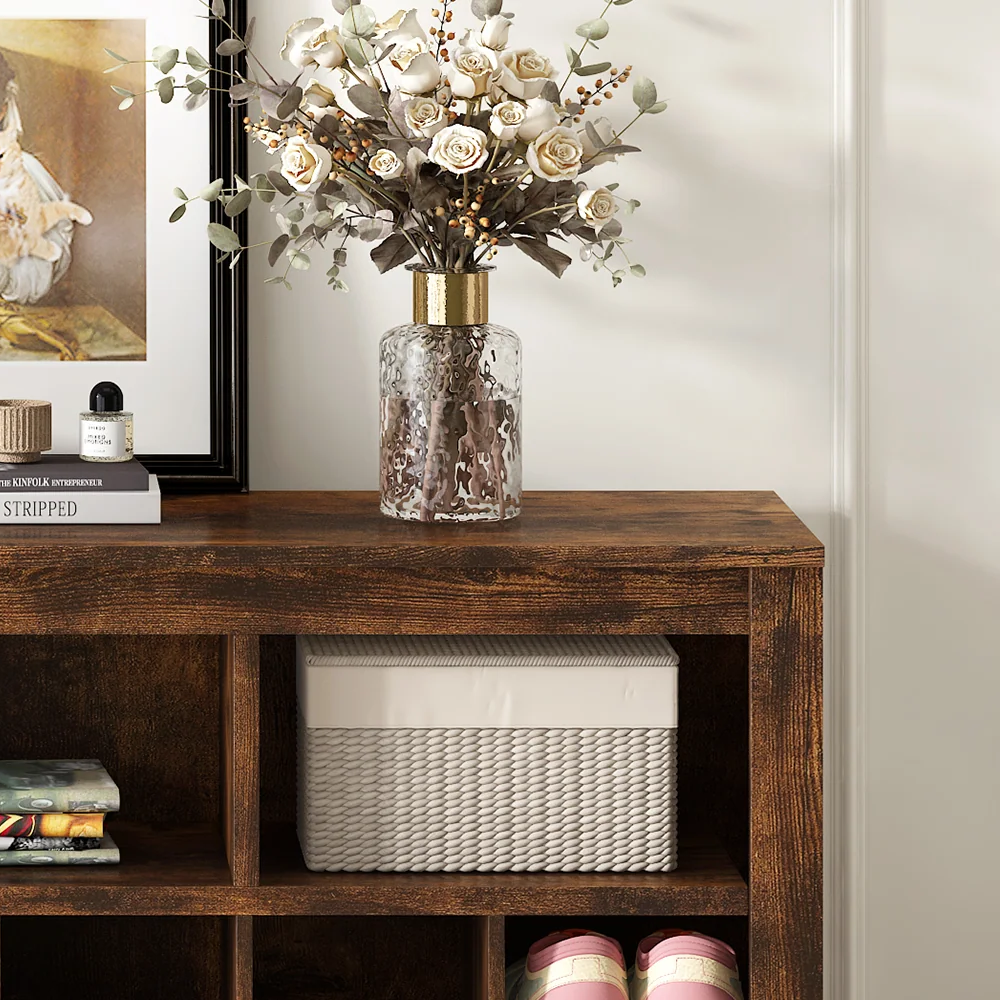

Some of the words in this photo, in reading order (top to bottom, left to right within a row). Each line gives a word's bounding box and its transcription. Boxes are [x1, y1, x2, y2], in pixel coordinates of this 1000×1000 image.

[12, 477, 50, 487] KINFOLK
[51, 478, 103, 487] ENTREPRENEUR
[3, 500, 77, 517] STRIPPED
